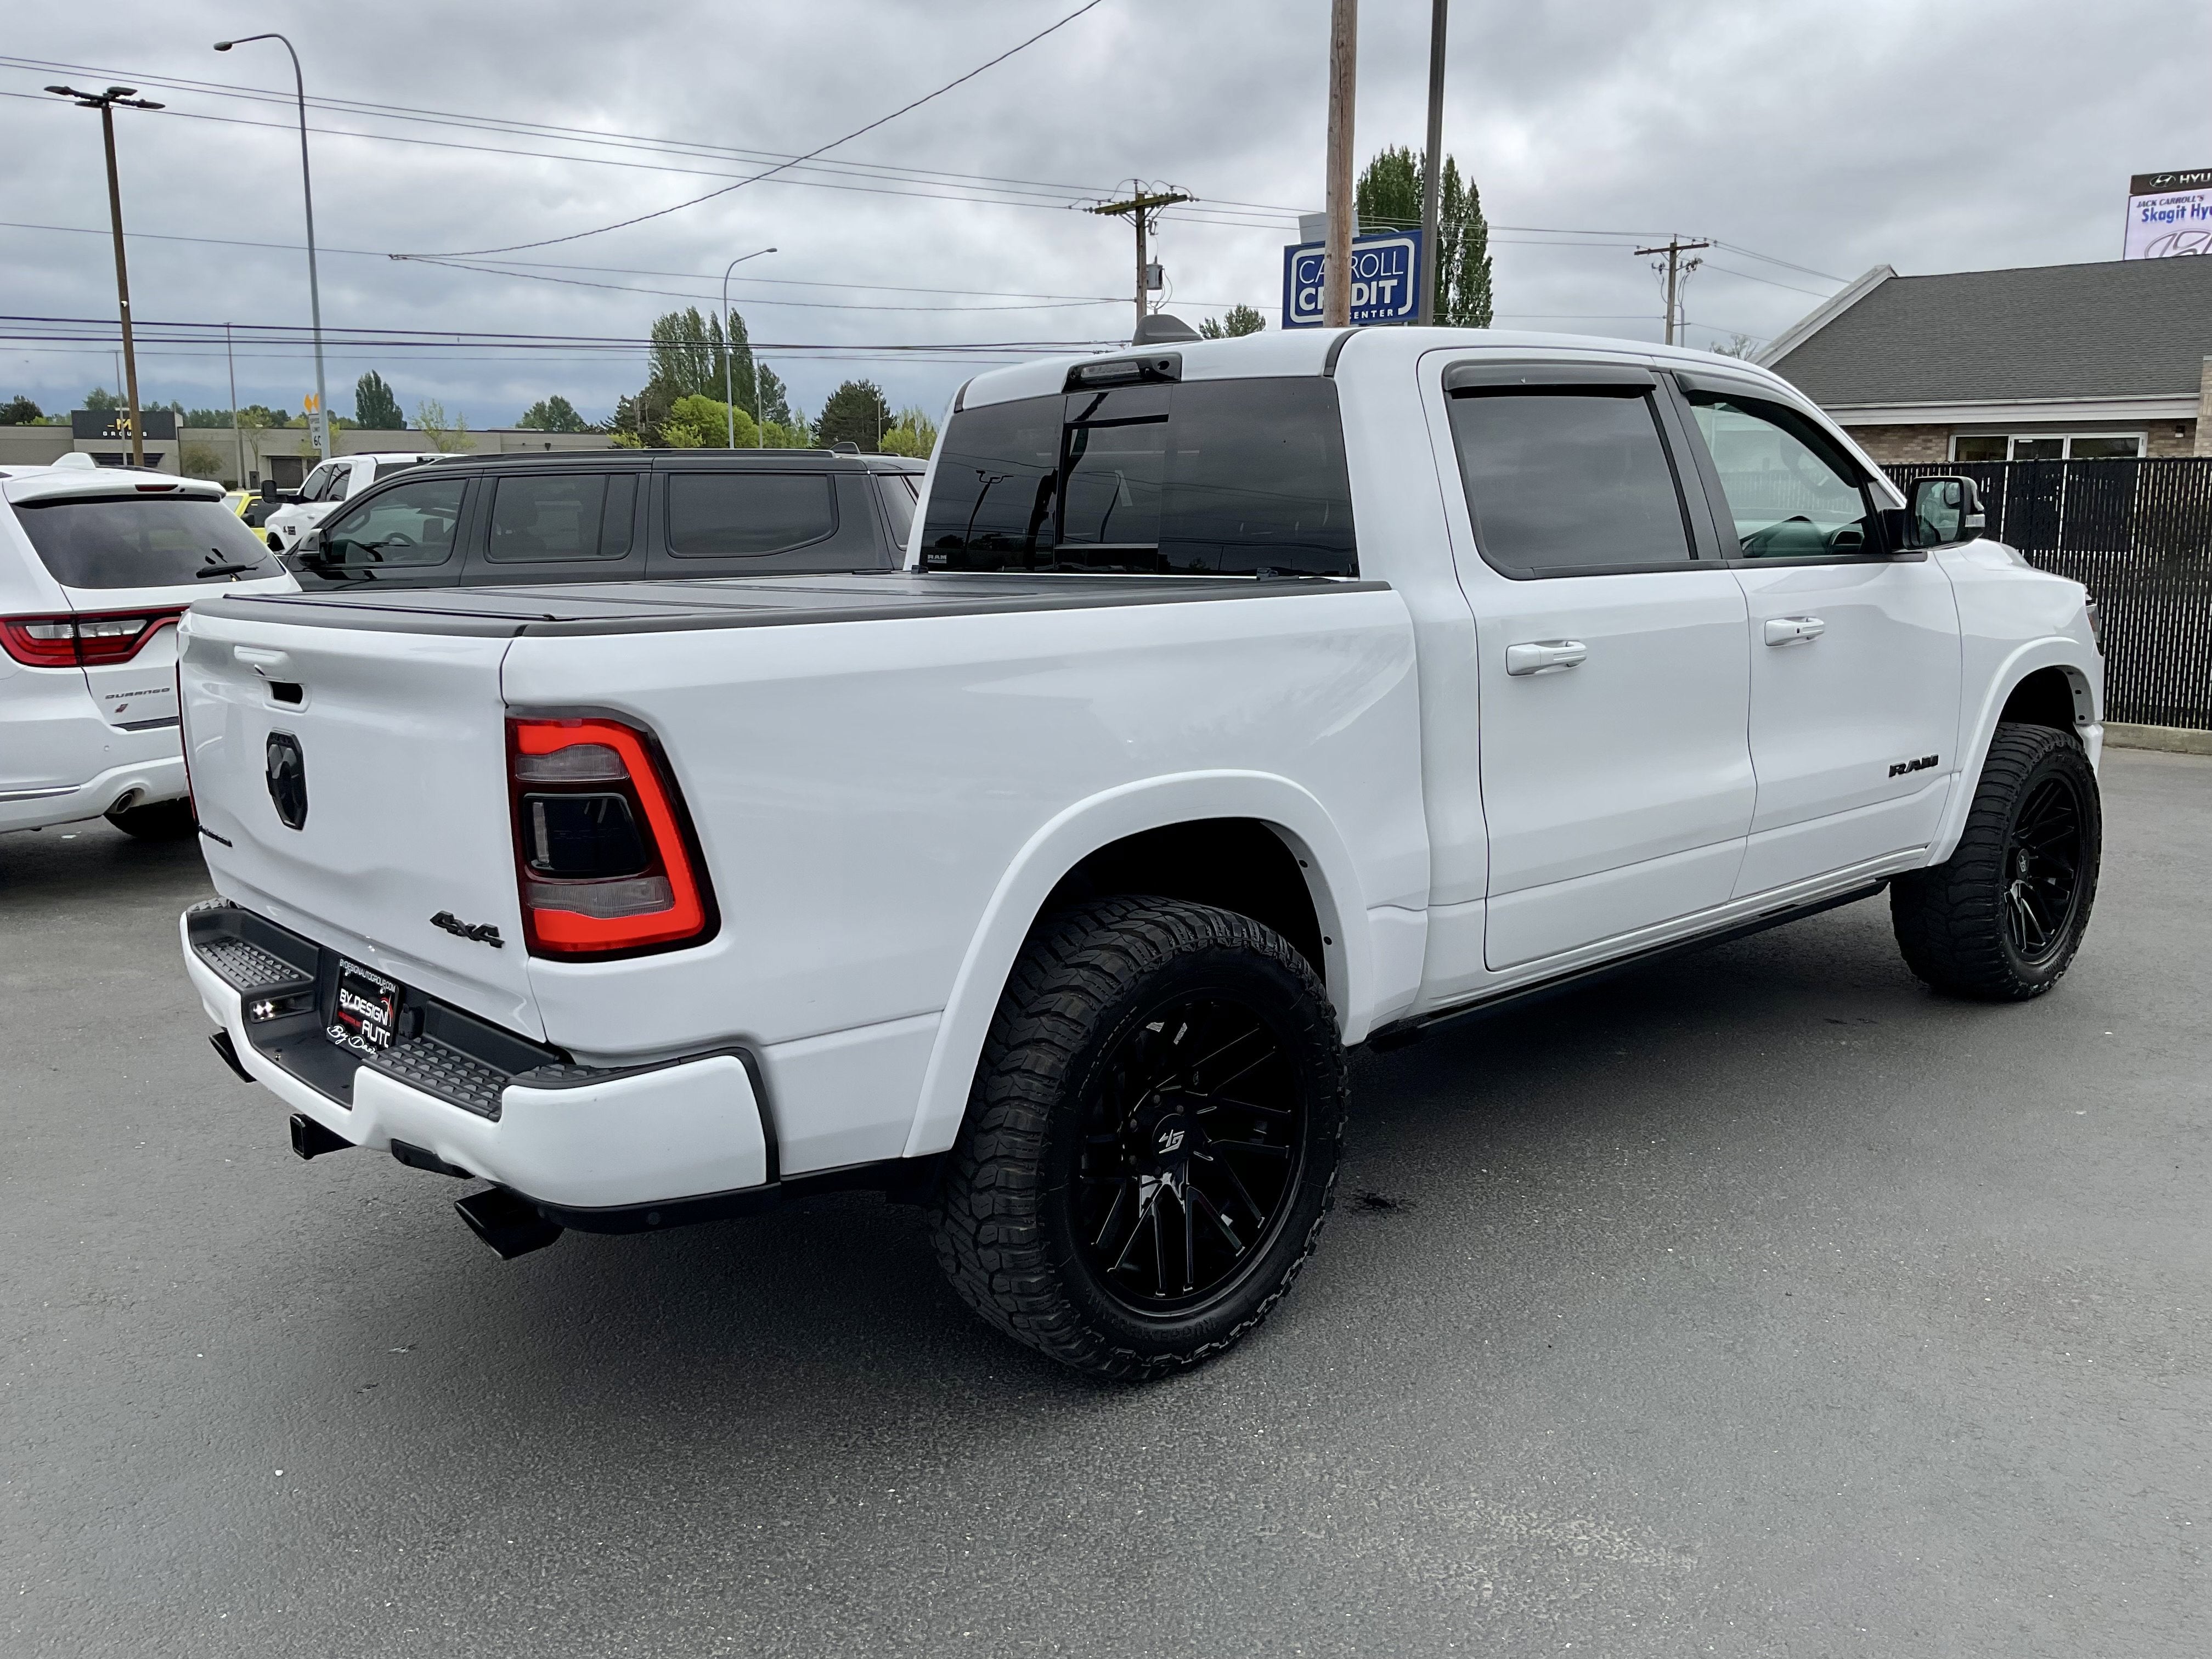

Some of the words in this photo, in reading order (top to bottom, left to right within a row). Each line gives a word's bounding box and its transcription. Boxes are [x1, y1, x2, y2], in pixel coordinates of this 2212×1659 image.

[2180, 172, 2211, 184] HYU
[2137, 199, 2157, 208] JACK
[2159, 195, 2205, 206] CARROLL'S
[2141, 205, 2187, 223] Skagit
[1299, 251, 1404, 284] CAROLL
[1299, 279, 1398, 311] CDIT
[1349, 309, 1393, 319] ENTER
[105, 687, 170, 699] DURANGO
[1888, 753, 1939, 778] RAM
[340, 988, 353, 1008] BY
[354, 995, 388, 1026] DESIGN
